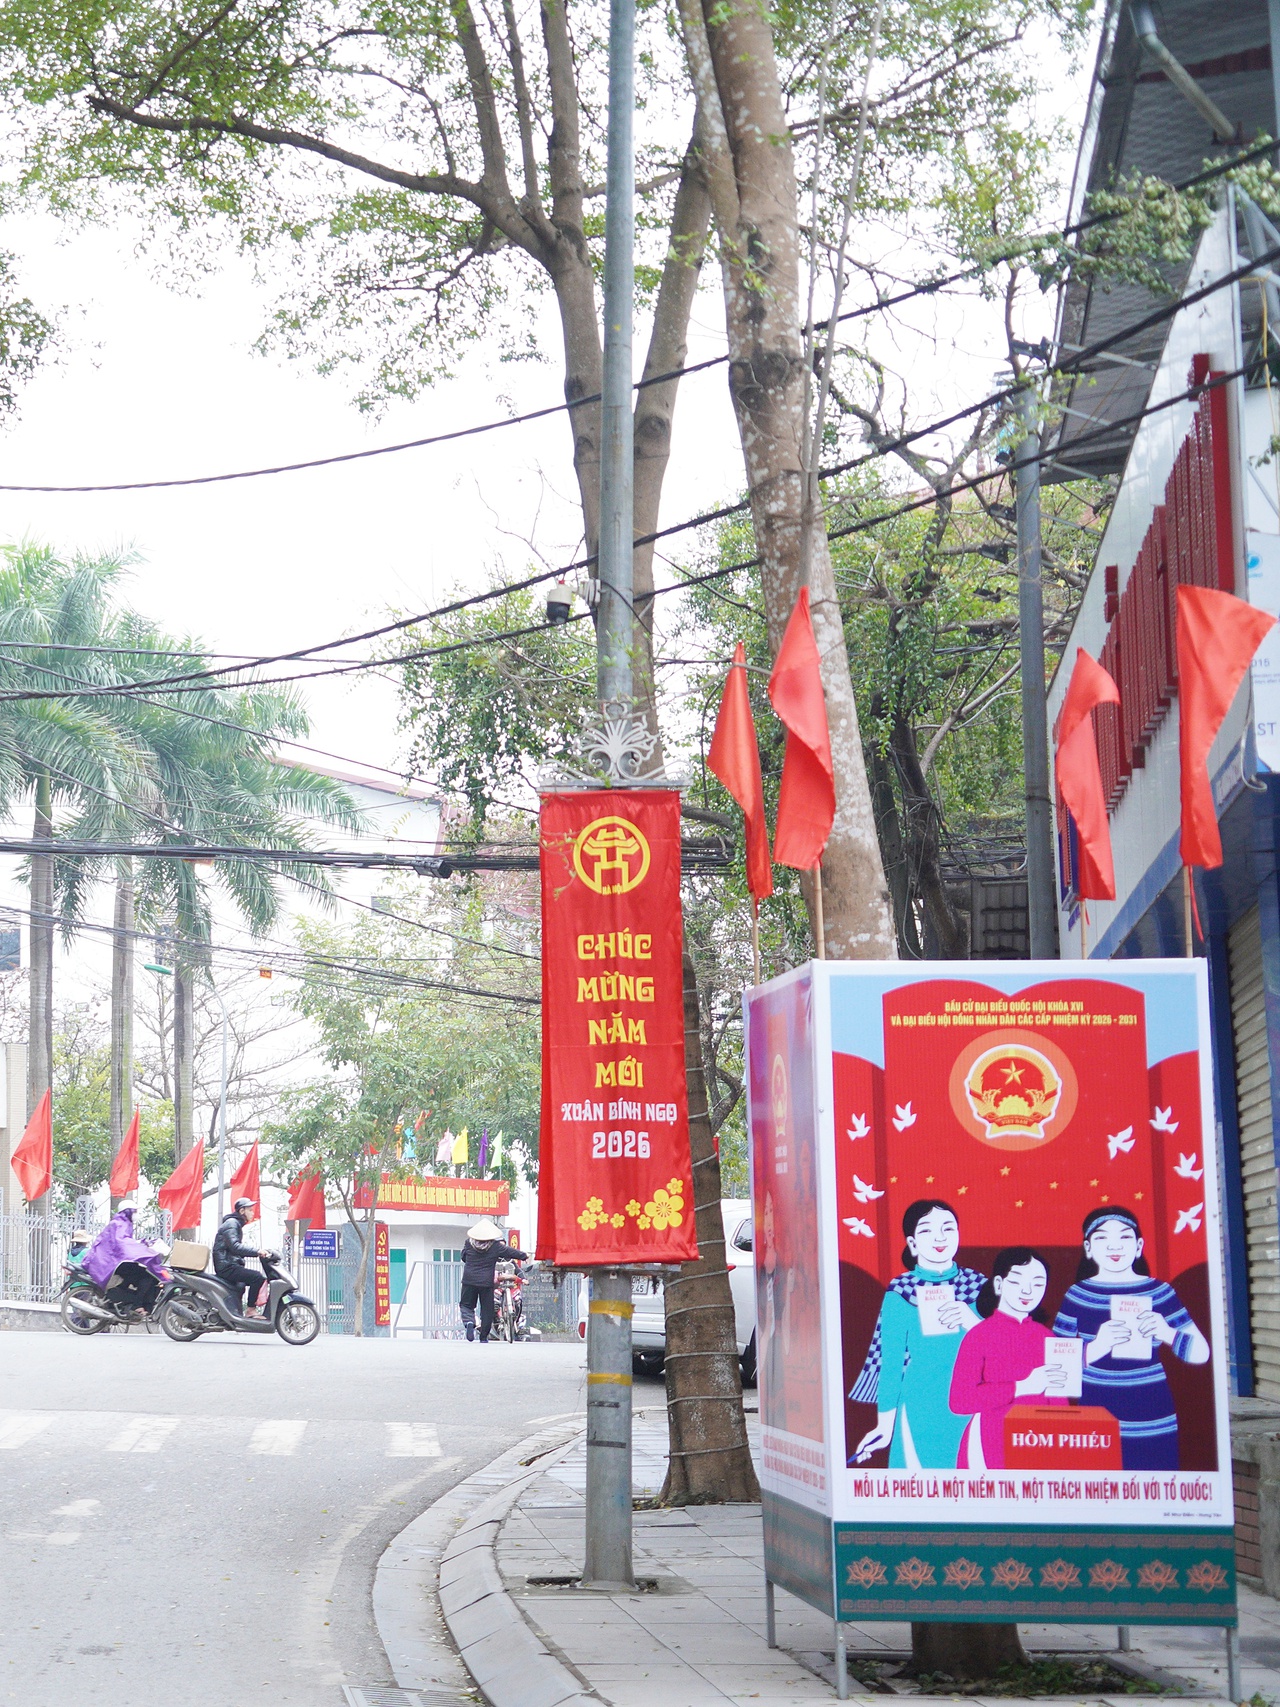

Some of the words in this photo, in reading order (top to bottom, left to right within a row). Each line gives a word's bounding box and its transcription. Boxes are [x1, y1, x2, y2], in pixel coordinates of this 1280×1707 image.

[577, 927, 652, 960] CHÚC
[576, 970, 655, 1003] MỪNG
[891, 1014, 901, 1026] VÀ
[903, 1016, 916, 1028] ĐẠI
[918, 1011, 936, 1026] BIỂU
[937, 1013, 951, 1028] HỘI
[952, 1012, 974, 1026] ĐỒNG
[975, 1013, 998, 1026] NHÂN
[999, 1013, 1016, 1026] DÂN
[1018, 1013, 1033, 1025] CÁC
[1035, 1011, 1051, 1025] CẤP
[1052, 1013, 1079, 1028] NHIỆM
[1080, 1013, 1090, 1025] KỲ
[1092, 1015, 1112, 1024] 2026
[1119, 1015, 1137, 1024] 2031
[944, 999, 961, 1012] BẦU
[962, 998, 974, 1012] CỬ
[975, 1002, 988, 1013] ĐẠI
[989, 998, 1008, 1012] BIỂU
[1009, 998, 1031, 1013] QUỐC
[1032, 999, 1046, 1013] HỘI
[1048, 1000, 1068, 1011] KHÓA
[1070, 1002, 1083, 1011] XVI
[588, 1011, 648, 1046] NĂM
[594, 1054, 644, 1088] MỚI
[561, 1099, 604, 1121] XUÂN
[608, 1097, 641, 1120] BÍNH
[645, 1103, 678, 1126] NGỌ
[592, 1130, 651, 1159] 2026
[1012, 1429, 1054, 1448] HÒM
[1058, 1430, 1112, 1448] PHIẾU
[854, 1472, 874, 1498] MỖI
[877, 1476, 890, 1498] LÁ
[893, 1473, 923, 1498] PHIẾU
[926, 1476, 940, 1498] LÀ
[942, 1476, 965, 1503] MỘT
[969, 1474, 996, 1499] NIỀM
[999, 1480, 1019, 1501] TIN,
[1022, 1477, 1044, 1504] MỘT
[1047, 1477, 1082, 1500] TRÁCH
[1085, 1477, 1120, 1504] NHIỆM
[1123, 1475, 1140, 1500] ĐỐI
[1143, 1476, 1161, 1500] VỚI
[1164, 1474, 1176, 1501] TỔ
[1180, 1475, 1213, 1503] QUỐC!
